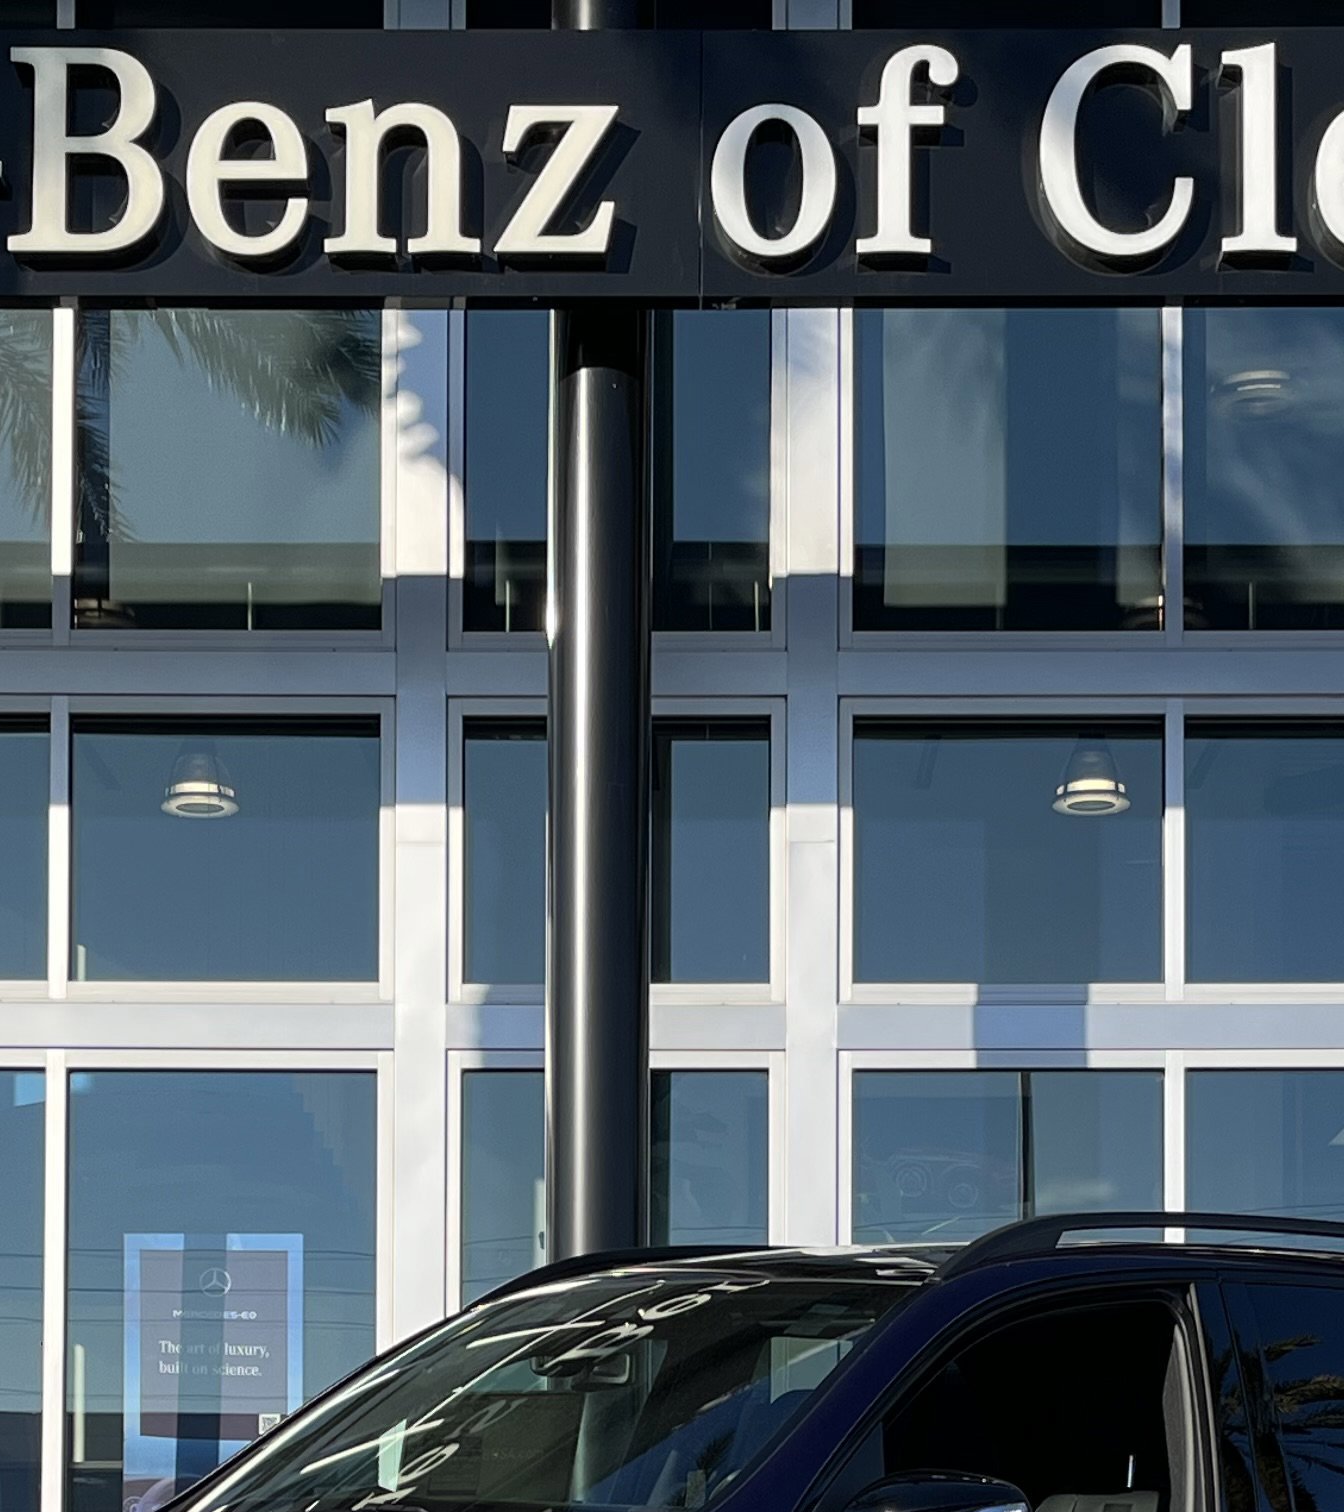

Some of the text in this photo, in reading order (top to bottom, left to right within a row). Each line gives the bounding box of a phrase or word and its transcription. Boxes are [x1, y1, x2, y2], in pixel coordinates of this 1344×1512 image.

[711, 44, 960, 256] of
[158, 1339, 183, 1354] The
[224, 1341, 270, 1359] luxury,
[158, 1360, 189, 1375] built
